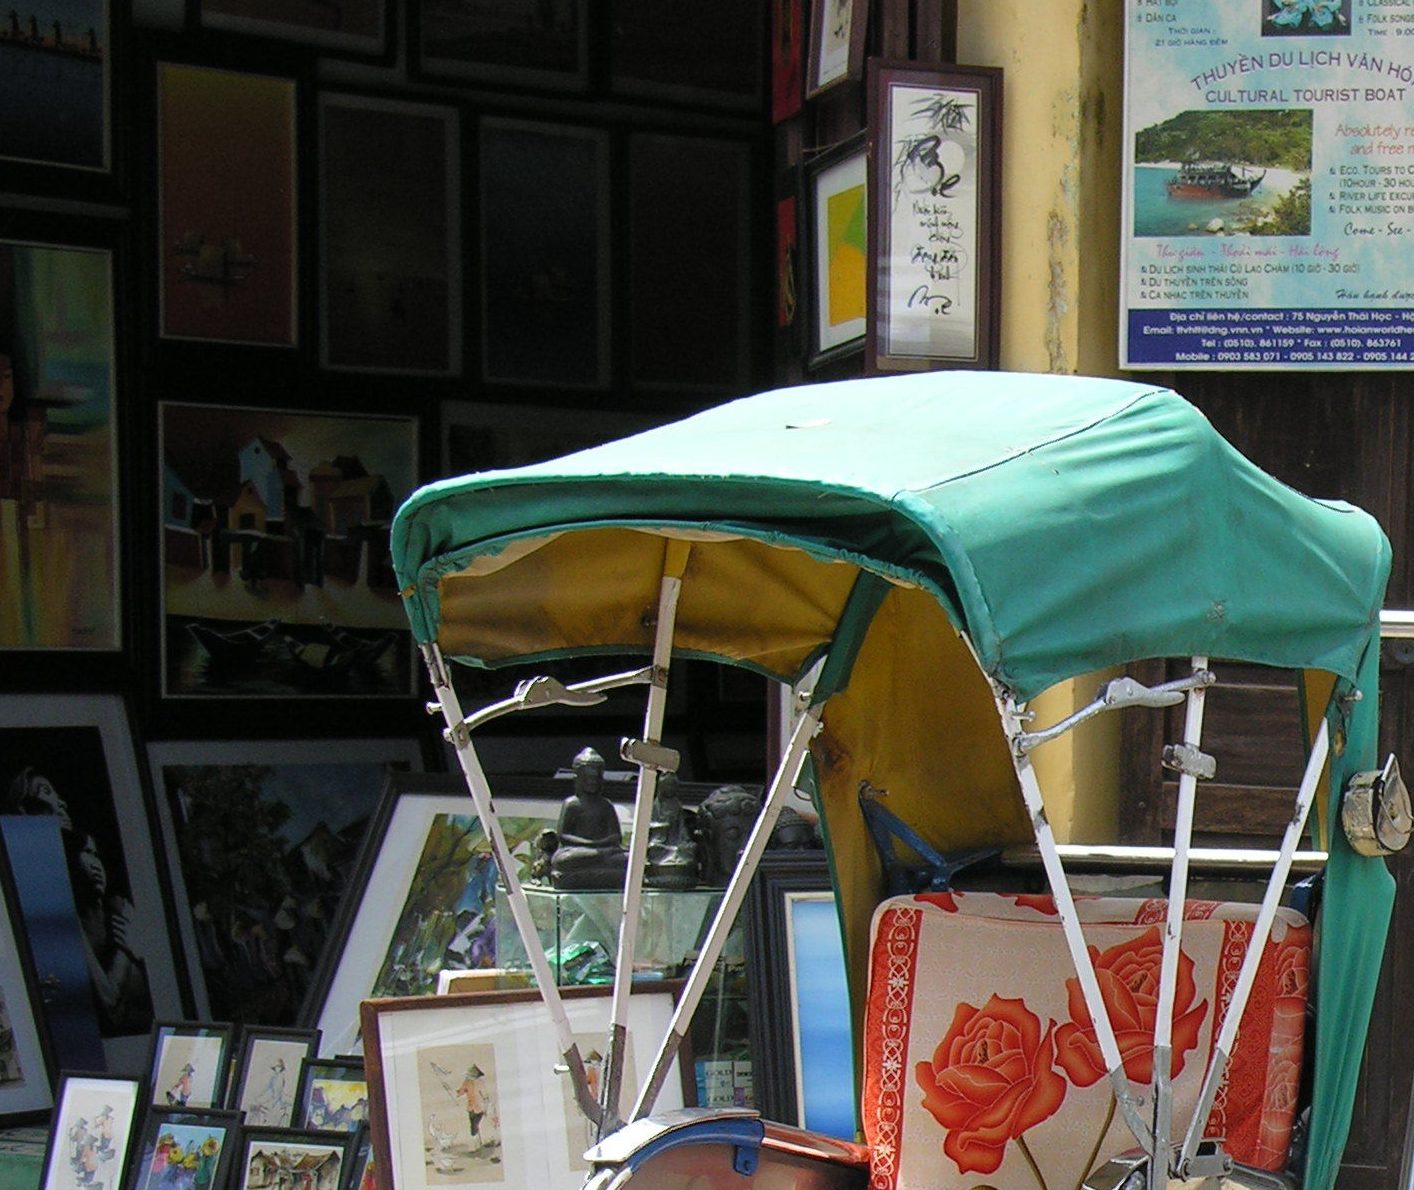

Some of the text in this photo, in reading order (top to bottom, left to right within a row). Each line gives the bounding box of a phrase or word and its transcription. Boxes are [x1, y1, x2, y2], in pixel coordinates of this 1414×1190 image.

[1269, 51, 1293, 68] DU
[1299, 51, 1341, 69] LỊCH
[1205, 88, 1406, 103] CULTURAL TOURIST BOAT
[1335, 123, 1401, 140] Absolutely
[1350, 142, 1374, 155] and
[1377, 141, 1404, 155] free
[1383, 178, 1397, 188] 30
[1339, 191, 1365, 201] RIVER
[1339, 204, 1362, 214] FOLK
[1364, 205, 1390, 214] MUSIC
[1393, 205, 1405, 214] ON
[1344, 222, 1376, 236] Come
[1387, 221, 1406, 236] See
[1327, 264, 1341, 274] 30
[1169, 312, 1186, 322] Địa
[1292, 312, 1304, 320] 75
[1348, 312, 1369, 321] Thái
[1371, 312, 1392, 323] Học
[1201, 339, 1216, 347] Tel
[1259, 339, 1294, 347] 861159
[1366, 339, 1401, 347] 863761
[1175, 352, 1210, 361] Mobile
[1217, 353, 1241, 361] 0903
[1263, 353, 1280, 361] 071
[1290, 352, 1314, 361] 0905
[1363, 352, 1387, 361] 0905
